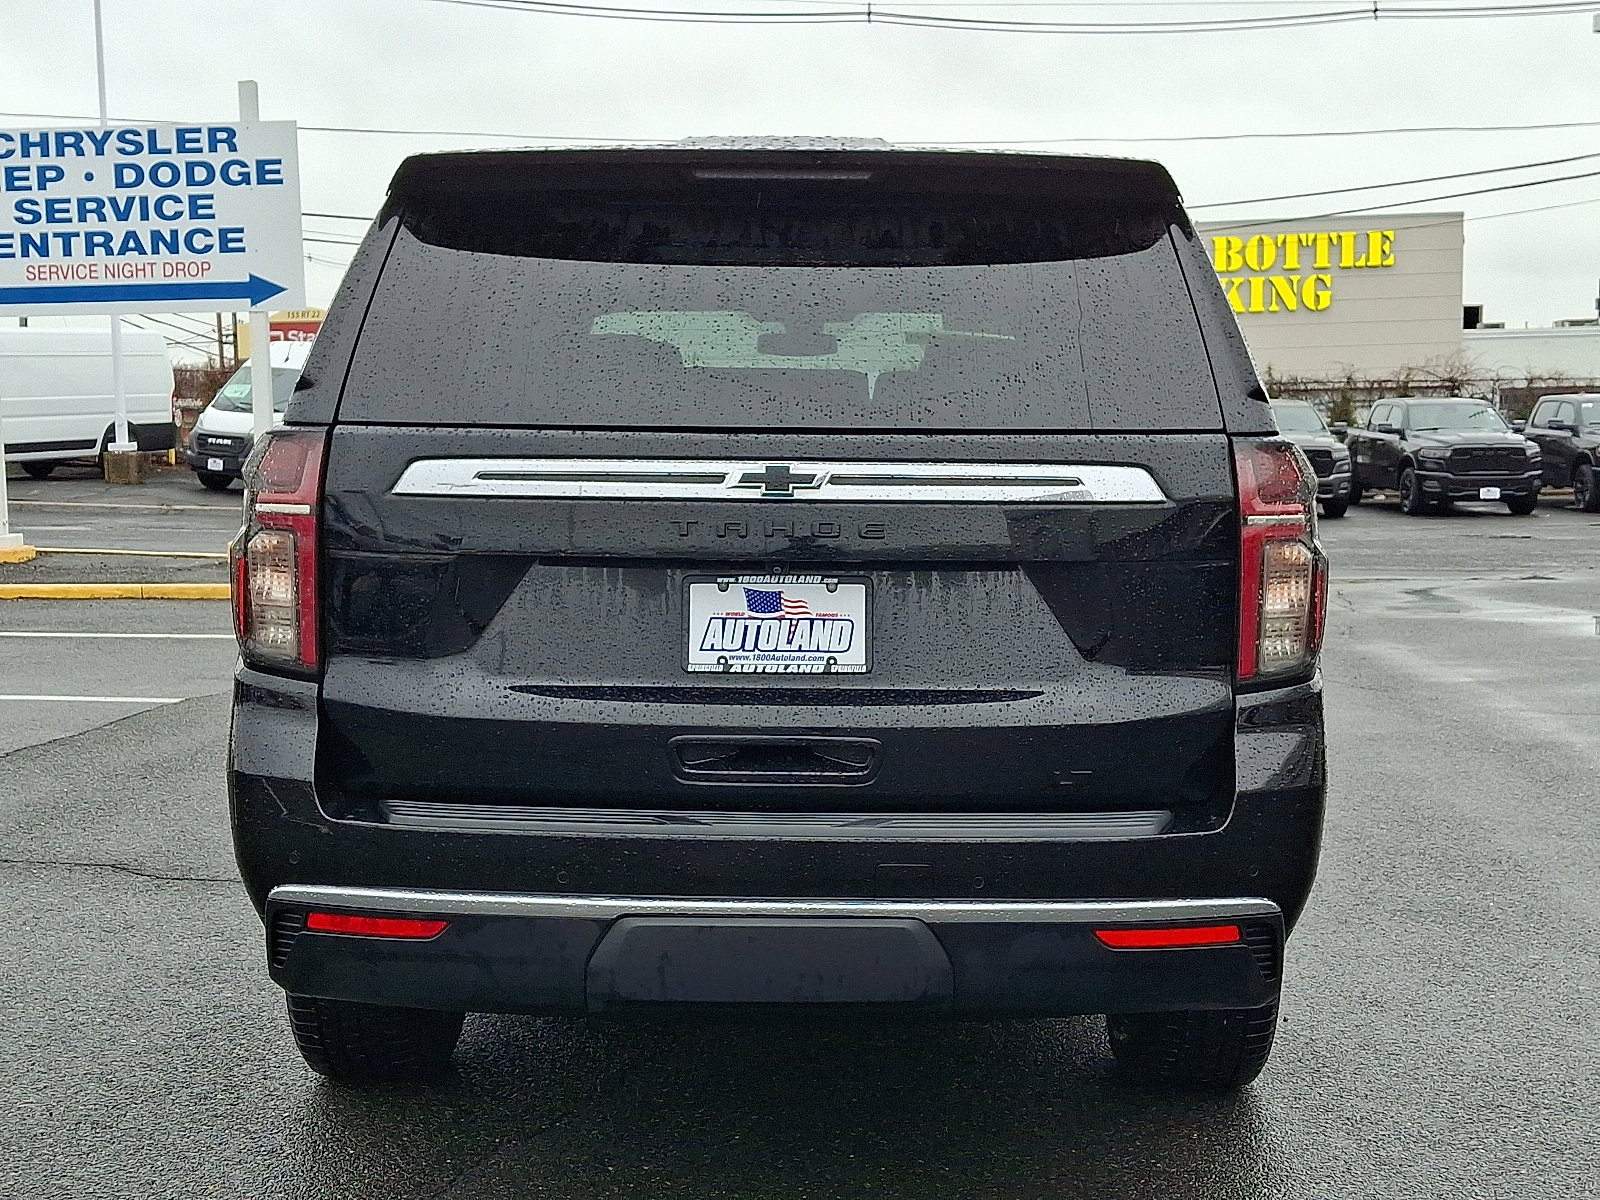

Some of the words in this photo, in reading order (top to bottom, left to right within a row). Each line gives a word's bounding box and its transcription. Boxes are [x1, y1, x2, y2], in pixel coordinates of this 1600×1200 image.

[0, 165, 65, 192] EP
[113, 158, 284, 189] DODGE
[13, 193, 216, 225] SERVICE
[0, 227, 246, 258] ENTRANCE
[1212, 230, 1395, 273] BOTTLE
[25, 263, 98, 281] SERVICE
[103, 262, 157, 279] NIGHT
[162, 261, 212, 278] DROP
[1220, 274, 1333, 313] KING
[670, 519, 886, 540] TAHOE
[699, 616, 855, 654] AUTOLAND
[729, 654, 825, 662] www.1800Autoland.com
[729, 664, 825, 673] AUTOLAND
